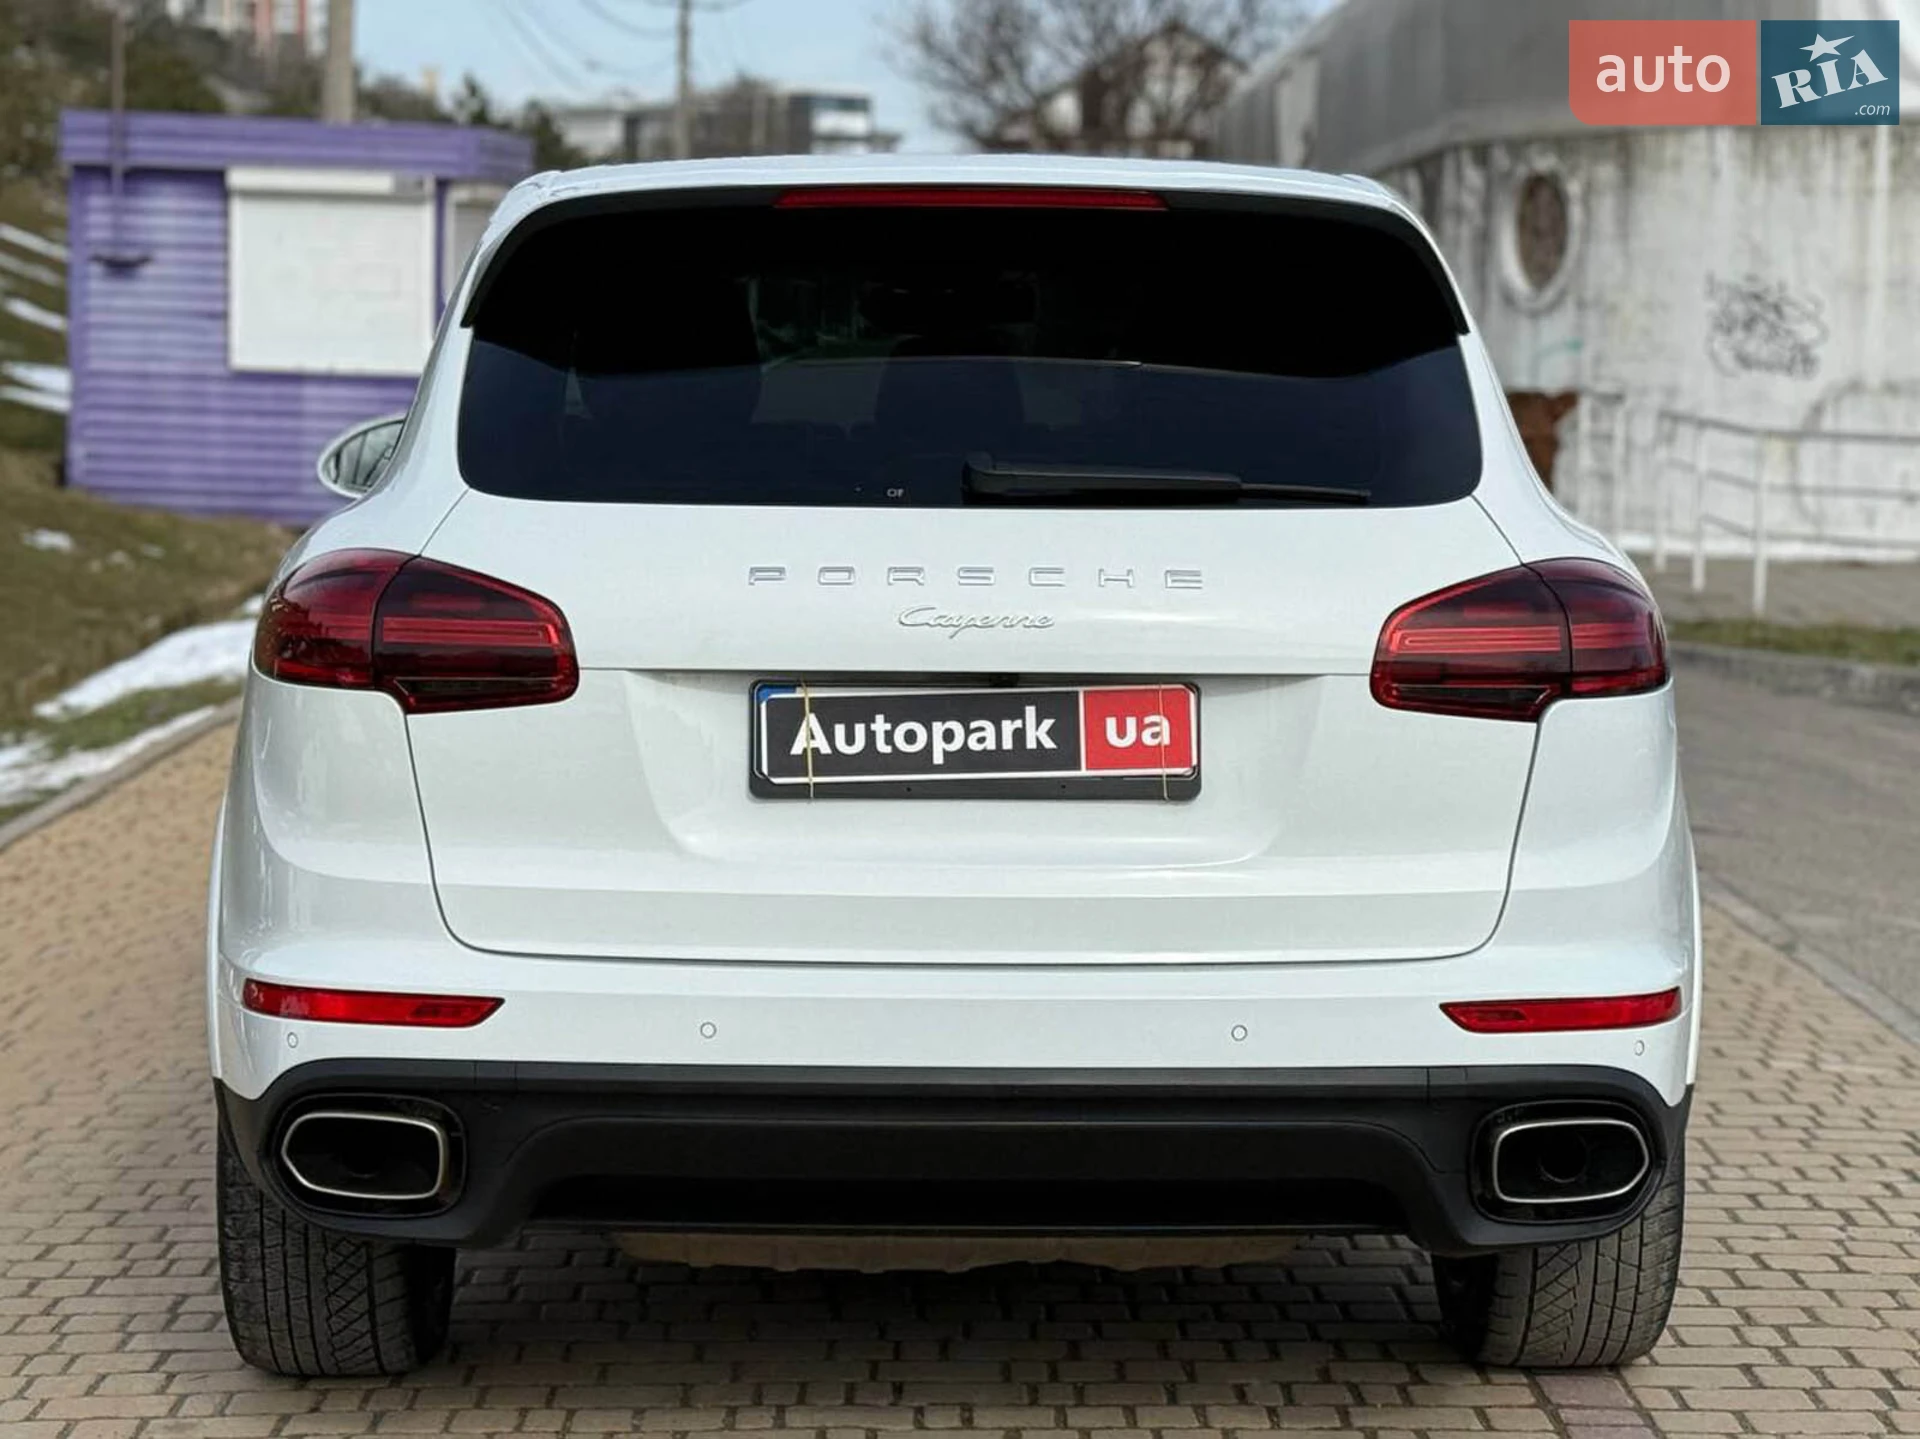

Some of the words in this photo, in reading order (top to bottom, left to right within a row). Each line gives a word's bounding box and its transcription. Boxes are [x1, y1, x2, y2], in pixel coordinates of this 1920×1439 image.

[748, 566, 1204, 590] PORSCHE
[898, 606, 1056, 639] Cayenne
[789, 705, 1058, 765] Autopark
[1104, 713, 1172, 748] ua
